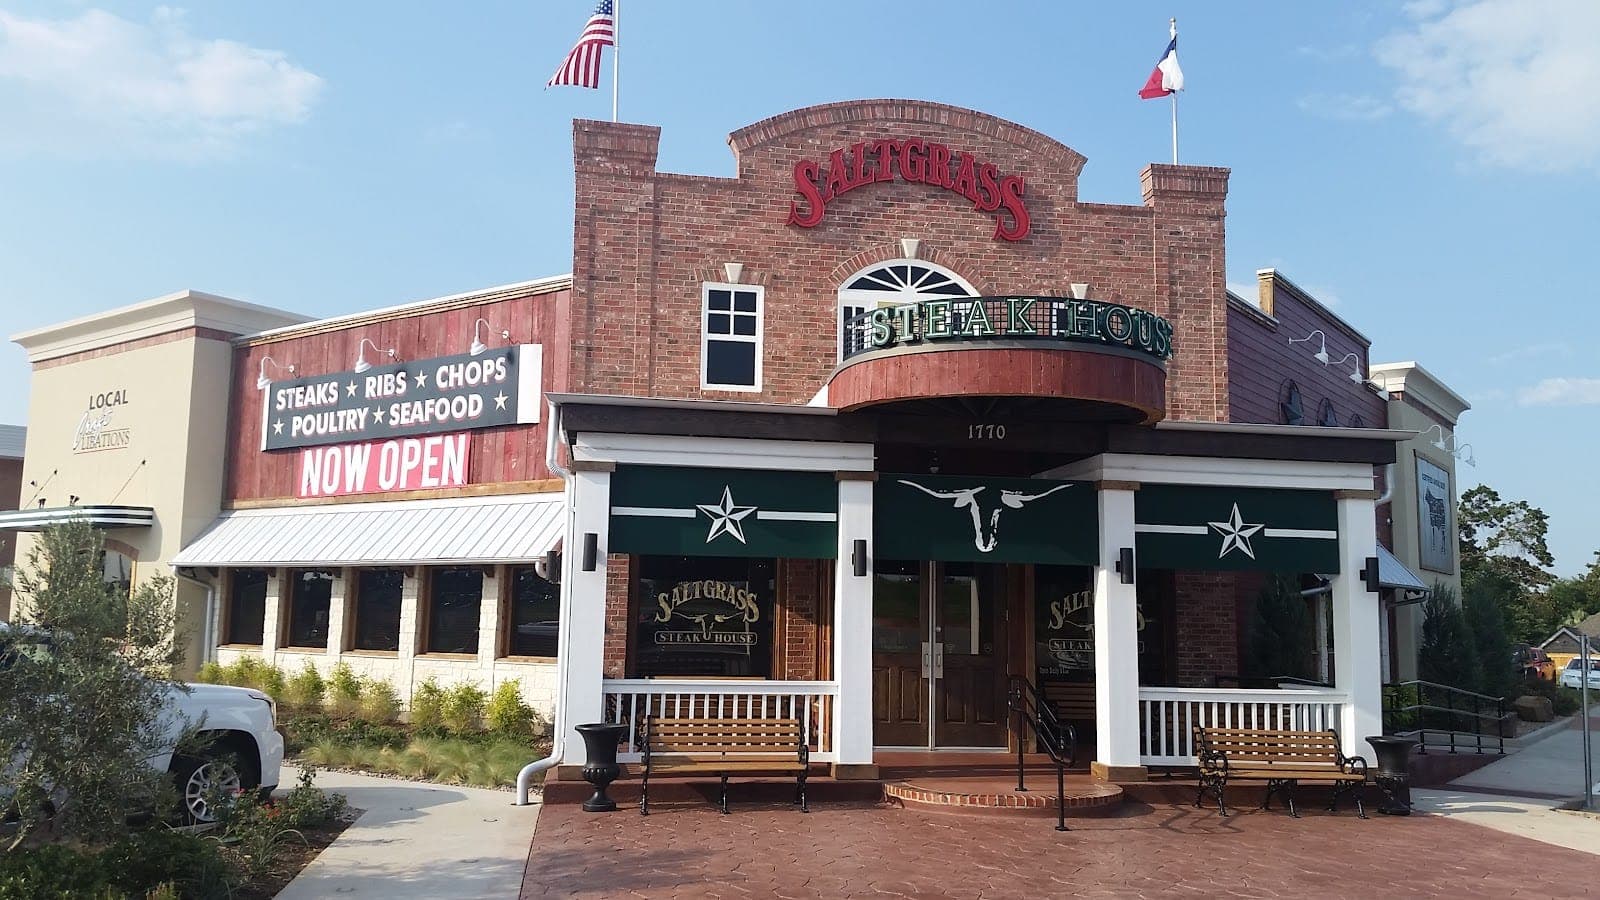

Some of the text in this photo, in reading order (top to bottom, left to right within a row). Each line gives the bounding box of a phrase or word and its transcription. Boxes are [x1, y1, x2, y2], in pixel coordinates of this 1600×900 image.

[786, 138, 1031, 241] SALTGRASS
[871, 298, 1036, 347] STEAK
[89, 389, 129, 410] LOCAL
[275, 357, 506, 411] STEAKS RIBS CHOPS
[291, 393, 483, 437] POULTRY SEAFOOD
[968, 424, 1006, 440] 1770
[301, 434, 467, 496] NOW OPEN
[654, 579, 760, 622] SALTGRASS
[660, 633, 755, 644] STEAK HOUSE
[1053, 641, 1092, 650] STEAK
